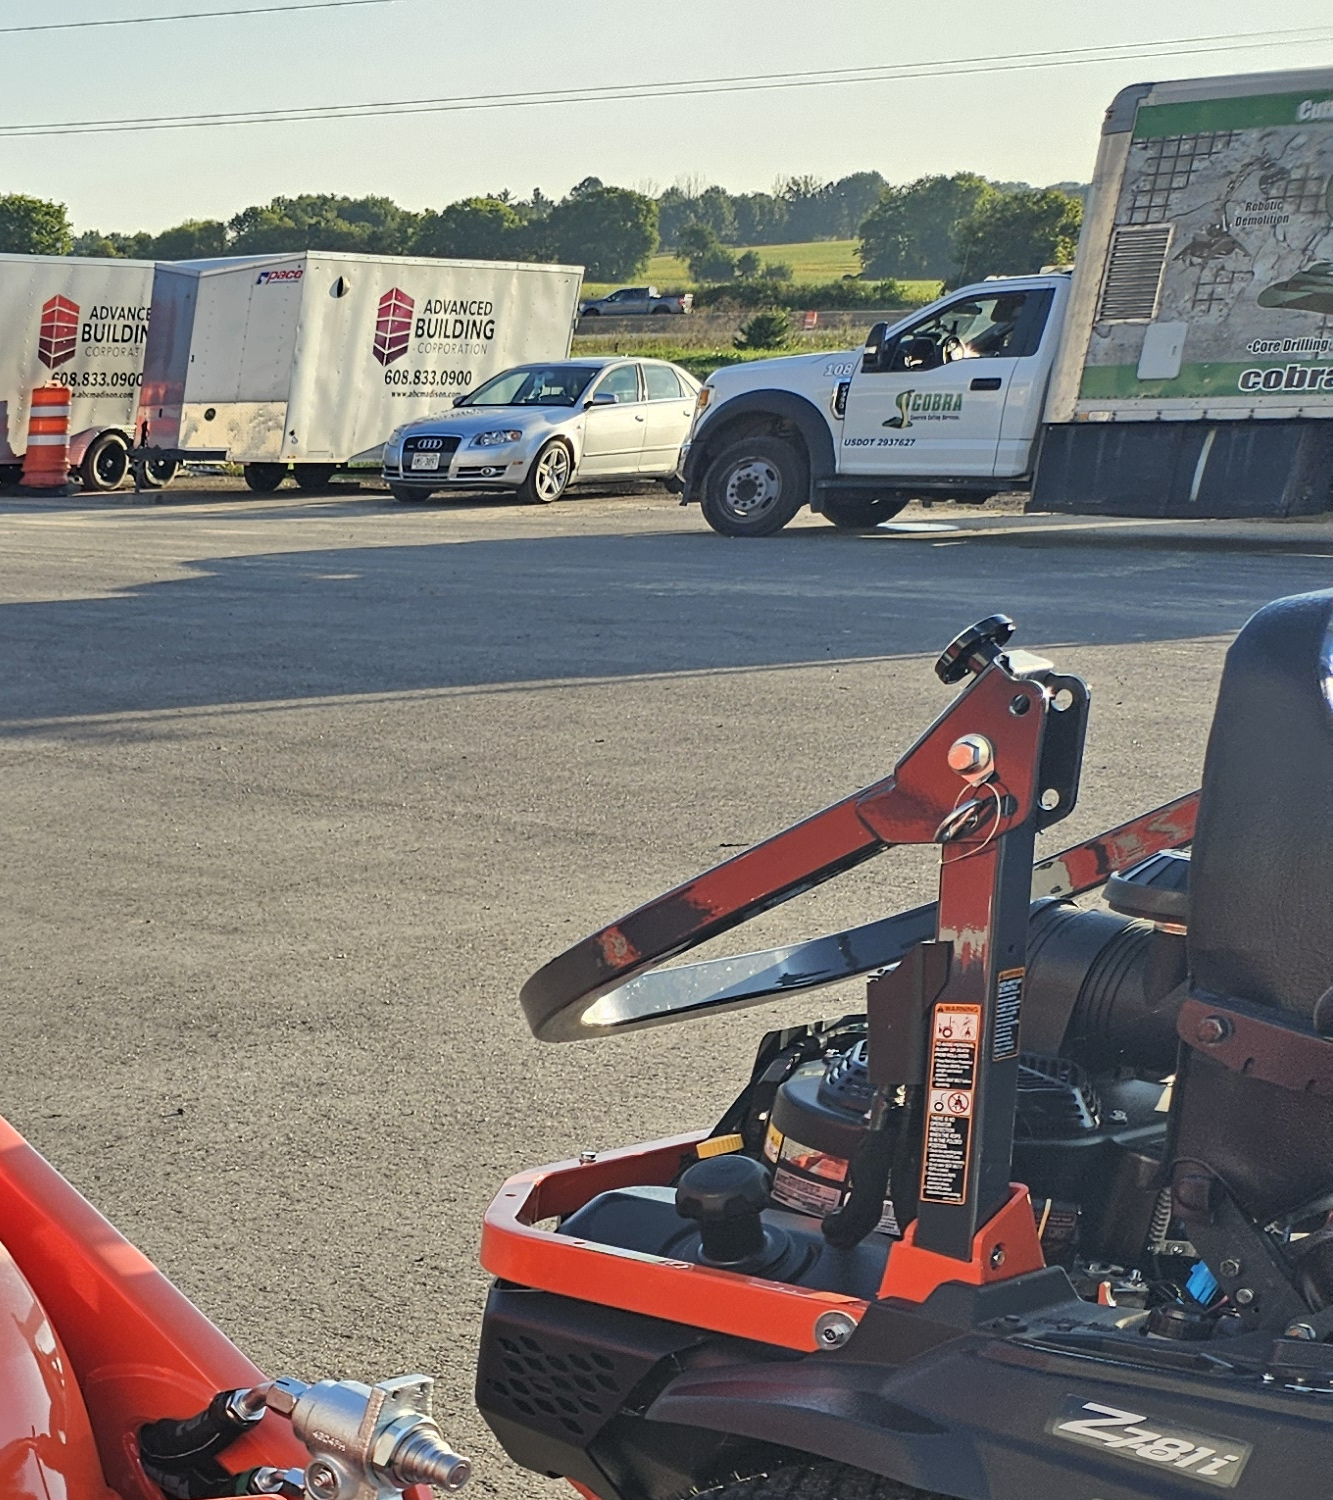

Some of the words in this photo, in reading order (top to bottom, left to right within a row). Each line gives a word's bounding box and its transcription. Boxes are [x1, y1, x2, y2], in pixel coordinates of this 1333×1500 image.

[1245, 201, 1284, 212] Robotic
[1235, 214, 1289, 227] Demolition
[89, 305, 152, 321] ADVANCE
[423, 299, 493, 316] ADVANCED
[82, 323, 149, 344] BUILDIN
[414, 318, 496, 340] BUILDING
[416, 342, 488, 354] CORPORATION
[1283, 338, 1329, 352] Drilling
[384, 369, 472, 386] 608.833.0900
[823, 364, 853, 376] 108
[911, 393, 963, 412] COBRA
[844, 438, 875, 447] USDOT
[877, 438, 916, 447] 2937627
[945, 1005, 979, 1013] WARNING
[1058, 1401, 1239, 1476] Z781i
